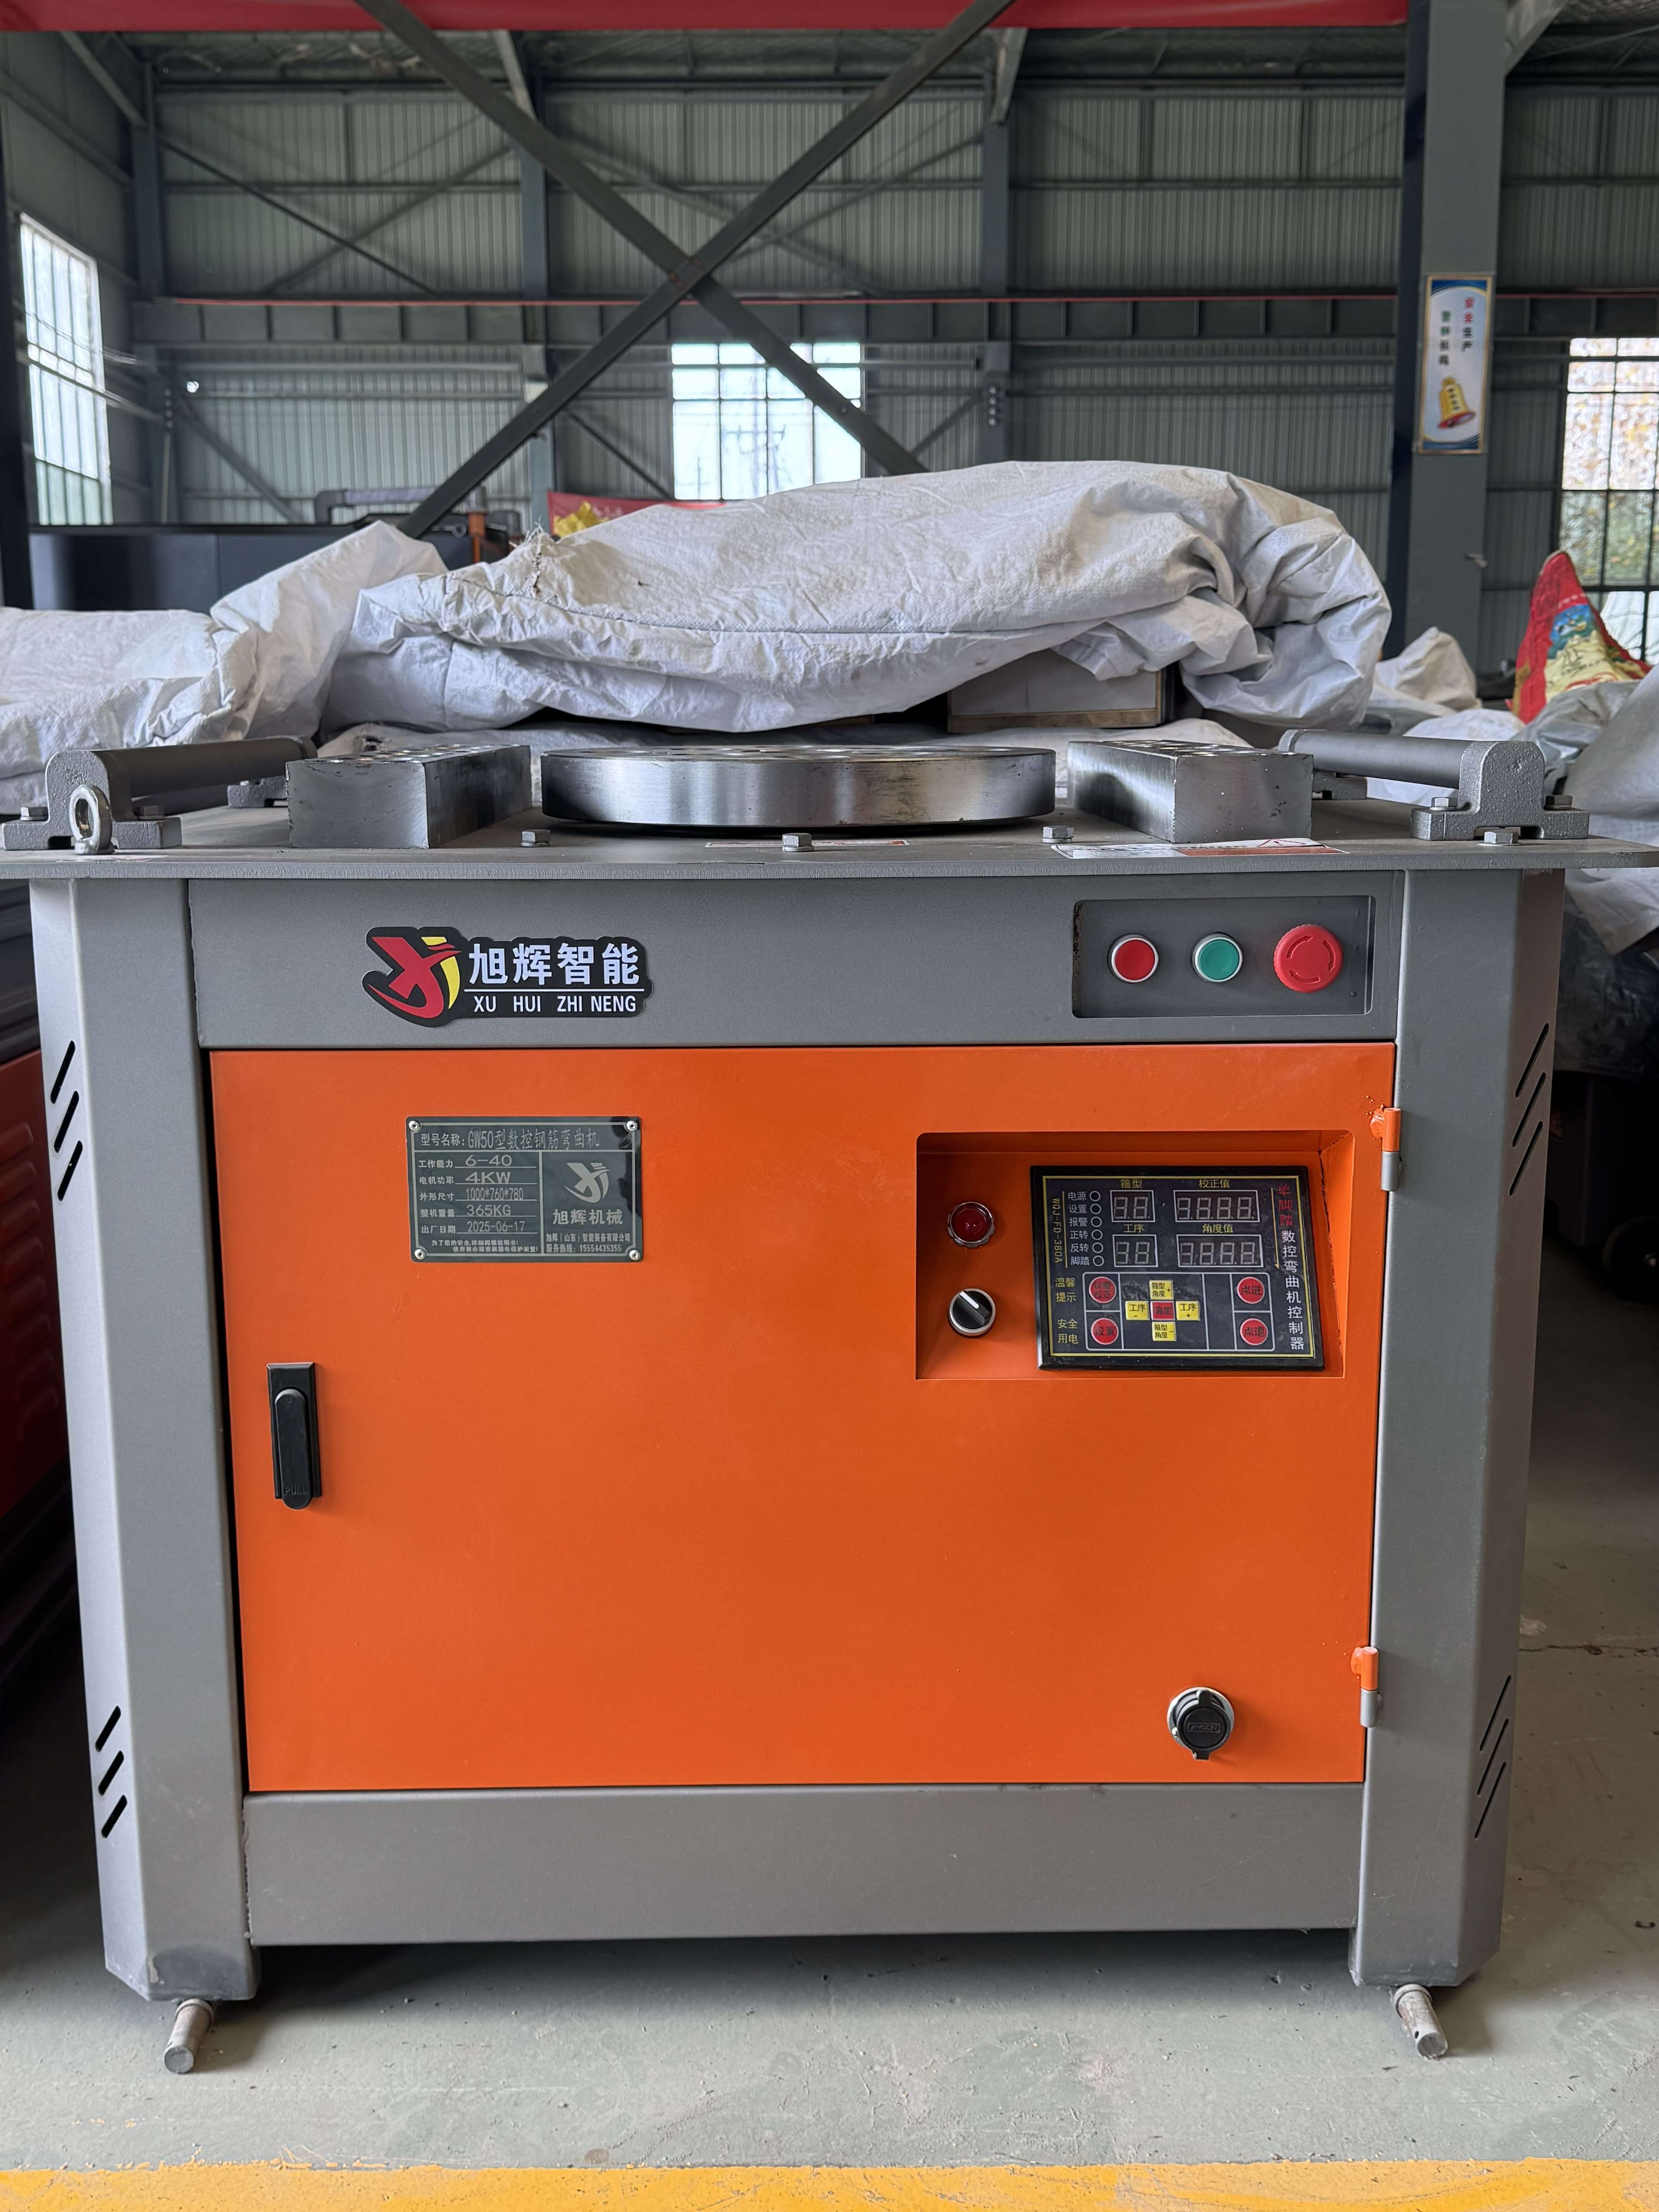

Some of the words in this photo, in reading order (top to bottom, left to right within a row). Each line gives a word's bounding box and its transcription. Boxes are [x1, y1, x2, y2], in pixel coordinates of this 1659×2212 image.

[469, 943, 639, 985] 旭辉智能
[474, 996, 496, 1012] XU
[513, 996, 541, 1012] HUI
[557, 996, 582, 1012] ZHI
[591, 996, 636, 1012] NENG
[468, 1128, 599, 1150] GW50型数控钢筋弯曲机
[418, 1159, 453, 1168] 工作能力
[465, 1155, 512, 1166] 6-40
[419, 1176, 454, 1185] 电机功率
[465, 1172, 511, 1183] 4KW
[1199, 1179, 1230, 1188] 校正值
[419, 1193, 455, 1201] 外形尺寸
[1068, 1192, 1087, 1201] 电源
[420, 1209, 455, 1217] 整机重量
[466, 1204, 511, 1216] 365KG
[1069, 1204, 1087, 1214] 设置
[553, 1209, 623, 1225] 旭辉机械
[1069, 1217, 1088, 1226] 报警
[421, 1225, 456, 1234] 出厂日期
[467, 1221, 525, 1232] 2025-06-17
[1124, 1224, 1144, 1233] 工序
[1202, 1224, 1234, 1233] 角度值
[1070, 1230, 1088, 1240] 正转
[1070, 1243, 1089, 1253] 反转
[1070, 1256, 1090, 1266] 脚踏
[1055, 1278, 1076, 1288] 温馨
[1056, 1292, 1076, 1302] 提示
[1058, 1319, 1078, 1329] 安全
[1058, 1334, 1079, 1344] 用电
[285, 1485, 307, 1495] PULL
